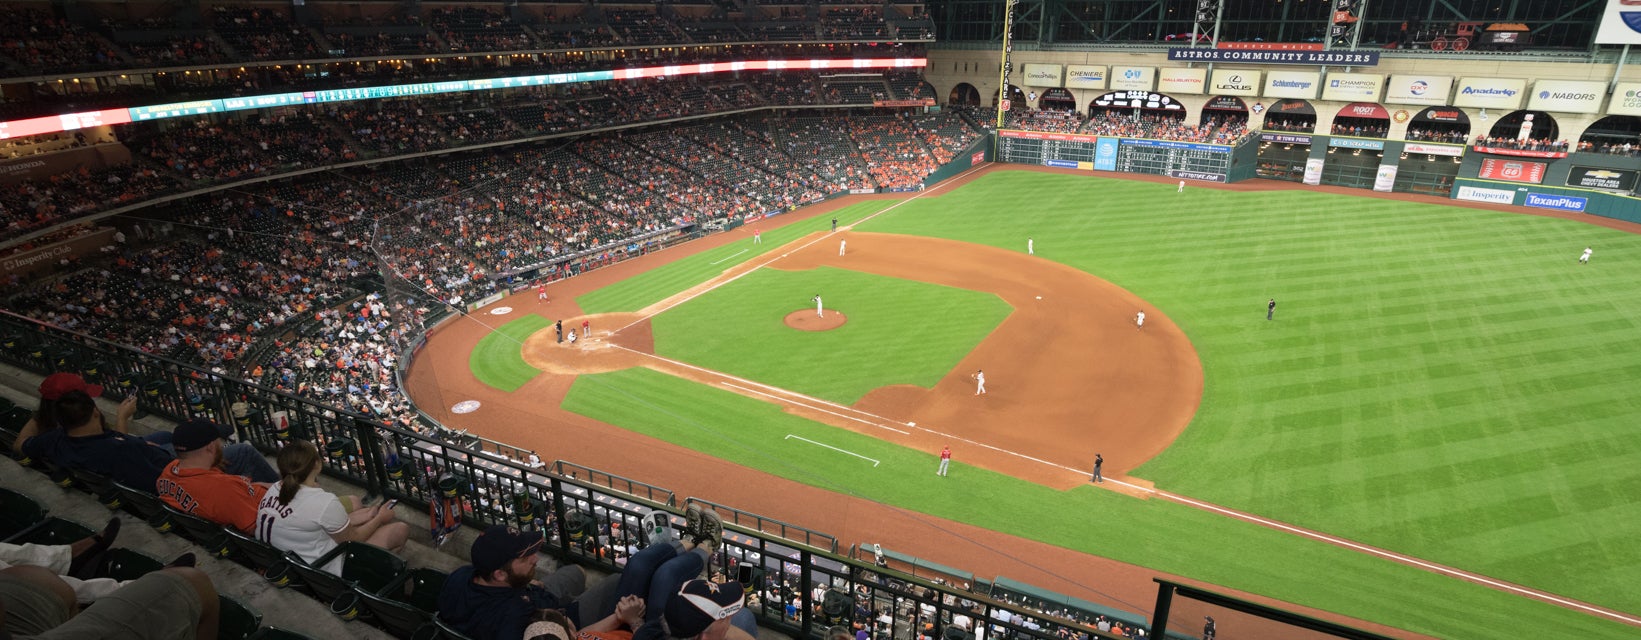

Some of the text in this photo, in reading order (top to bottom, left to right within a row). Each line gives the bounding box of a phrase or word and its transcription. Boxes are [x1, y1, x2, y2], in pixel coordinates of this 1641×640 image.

[1175, 51, 1371, 63] ASTROS COMMUNITY LEADERS
[1272, 79, 1312, 90] Schlumberger
[1461, 86, 1517, 97] Anadarko
[1551, 92, 1597, 101] NABORS
[8, 160, 46, 171] HONDA
[1471, 190, 1512, 200] Insperity
[1529, 195, 1582, 209] TexanPlus
[15, 245, 72, 267] Insperity Club
[260, 513, 275, 545] 11
